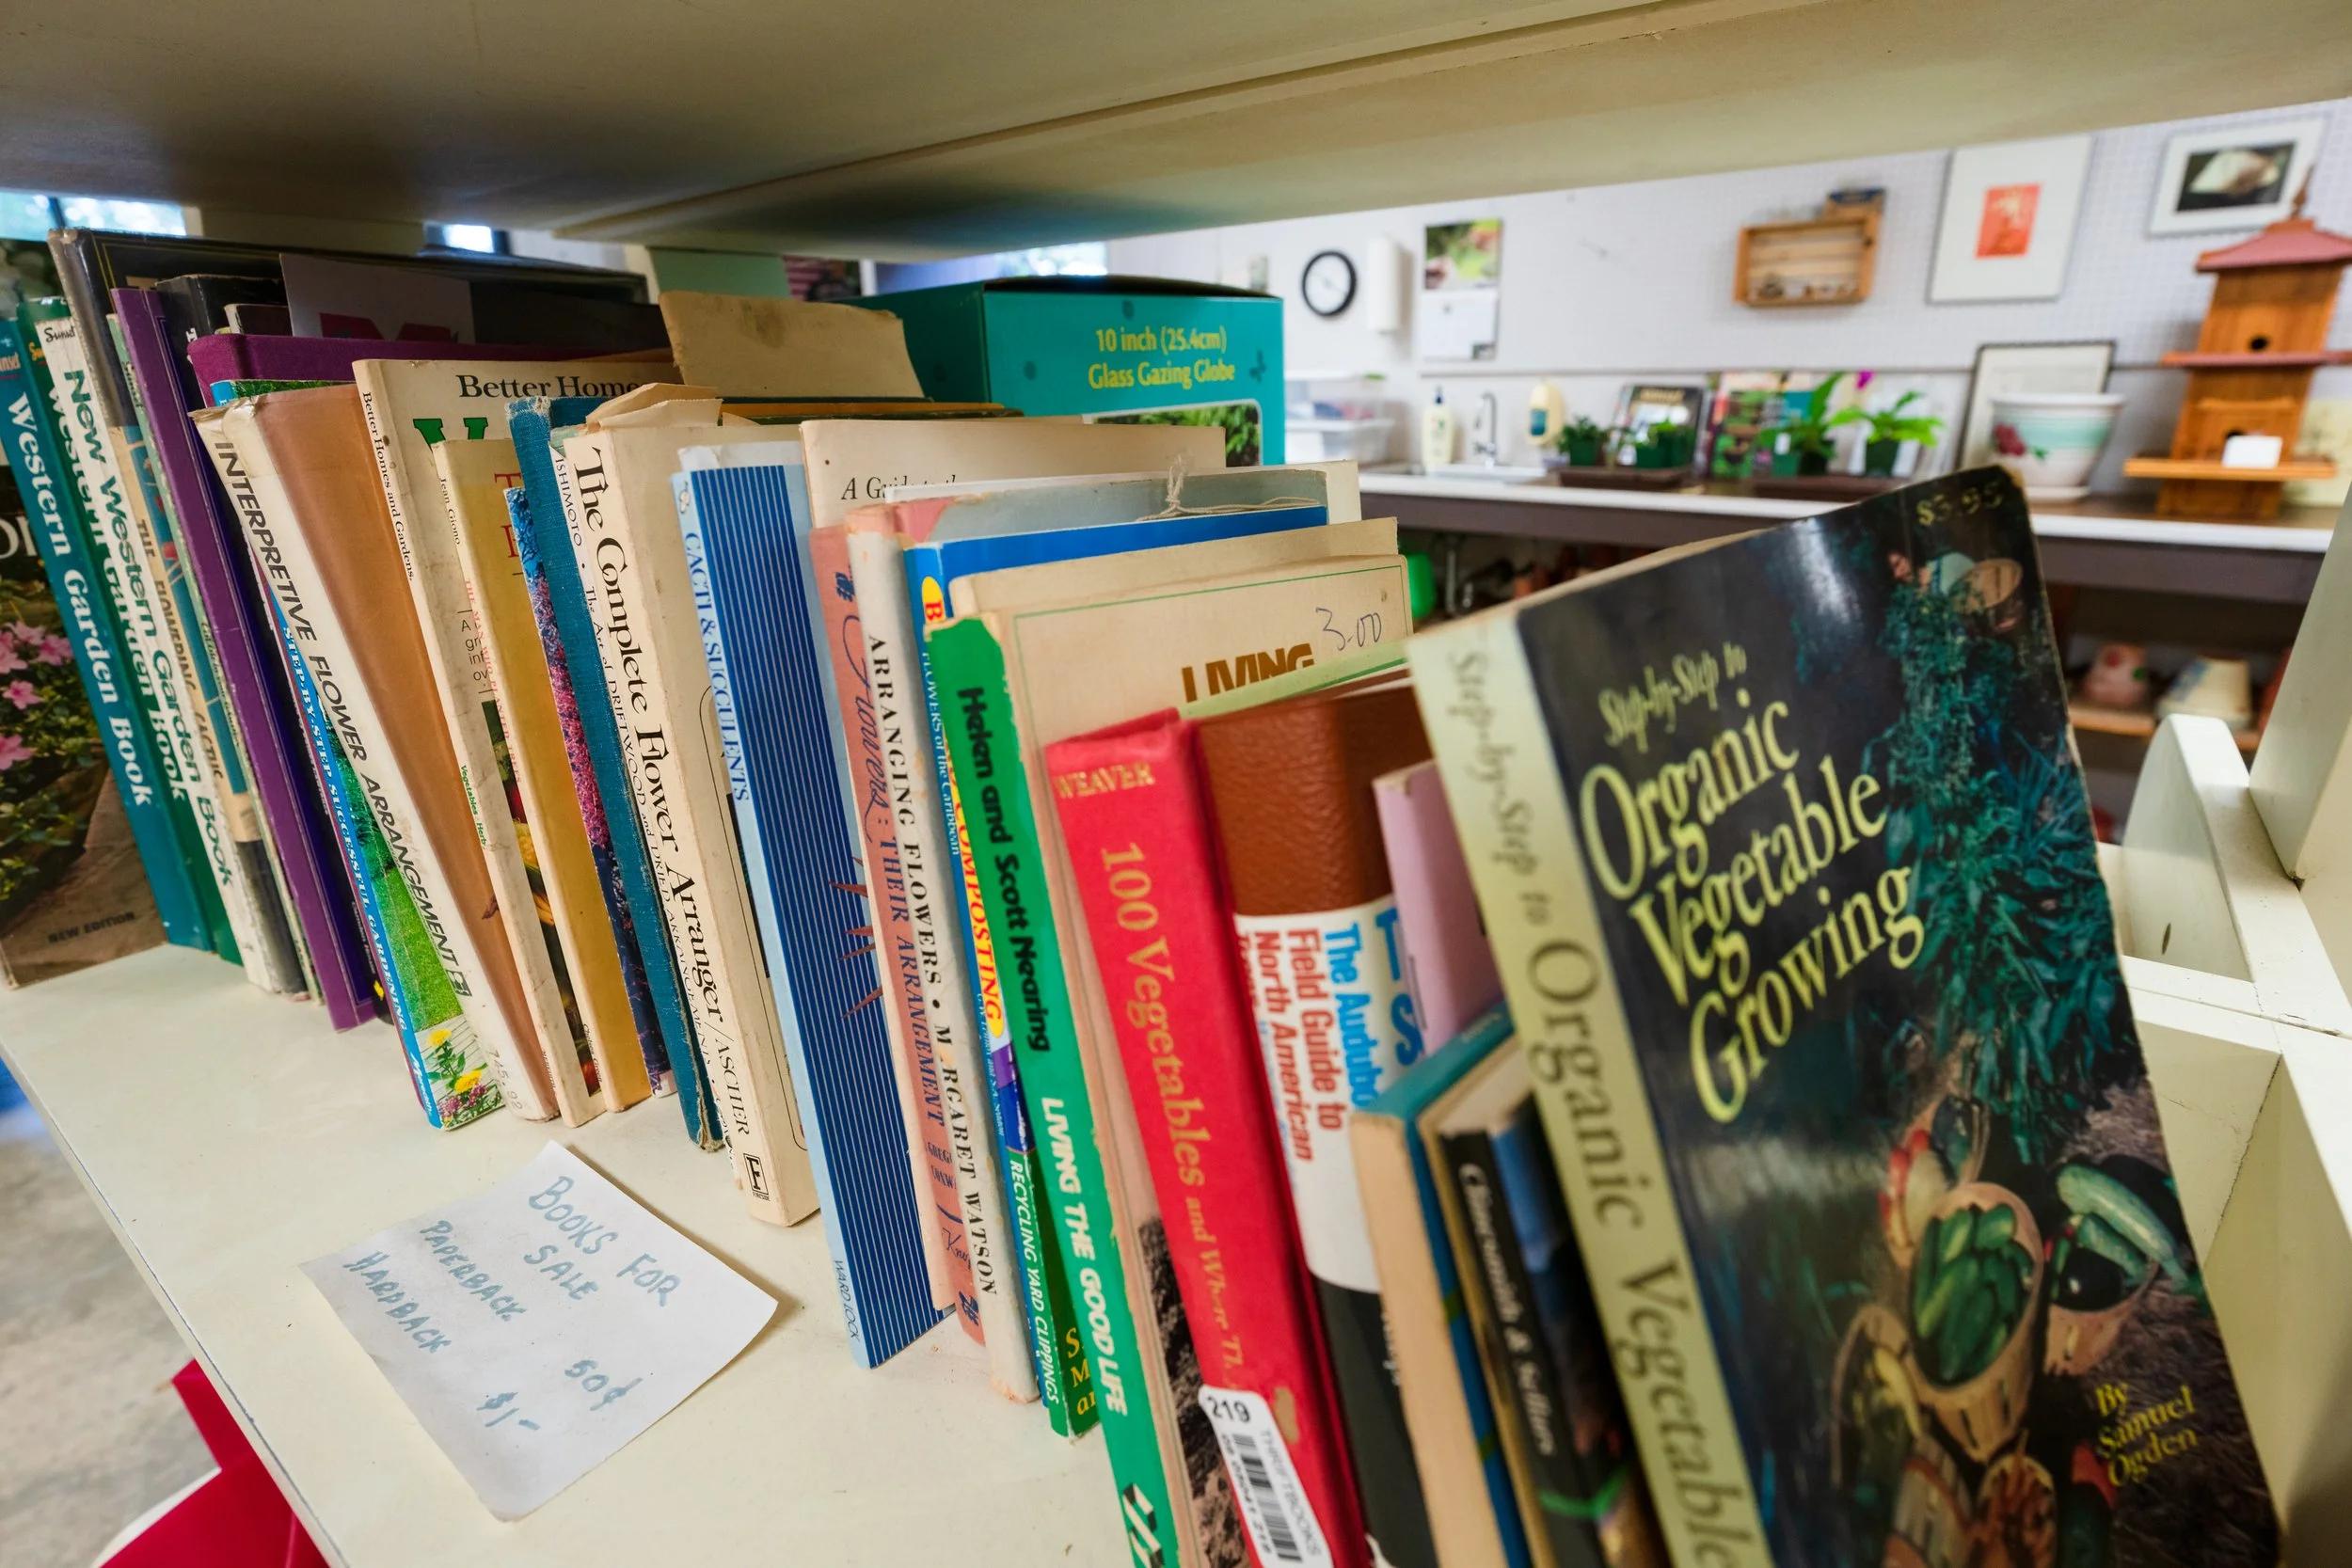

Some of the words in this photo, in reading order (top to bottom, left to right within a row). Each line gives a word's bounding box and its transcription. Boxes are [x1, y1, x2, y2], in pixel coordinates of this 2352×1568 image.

[43, 325, 75, 343] Sunset
[1088, 363, 1135, 389] Glass
[1136, 361, 1193, 390] Gazing
[1194, 358, 1235, 383] Globe
[1096, 328, 1117, 352] 10
[1120, 325, 1157, 352] inch
[1160, 325, 1227, 356] (25.4cm)
[456, 374, 550, 398] Better
[556, 374, 649, 397] Home
[362, 391, 378, 437] Better
[374, 437, 391, 490] Homes
[387, 491, 401, 518] and
[841, 477, 859, 500] A
[439, 478, 451, 504] Jean
[448, 509, 461, 546] Giono
[8, 391, 72, 557] Western
[64, 569, 119, 704] Garden
[109, 716, 151, 805] Book
[685, 532, 711, 610] CACTI
[64, 370, 107, 464] New
[100, 475, 158, 637] Western
[152, 649, 201, 784] Garden
[196, 796, 234, 887] Book
[461, 619, 471, 632] A
[466, 579, 475, 604] THE
[472, 611, 484, 640] MAN
[482, 646, 493, 674] WHO
[490, 681, 510, 739] PLANTED
[554, 458, 582, 547] ISHIMOTO
[584, 587, 596, 612] The
[593, 622, 606, 650] Art
[609, 680, 646, 806] DRIFTWOOD
[642, 813, 654, 837] and
[700, 618, 717, 636] &
[1315, 606, 1382, 651] 3.00
[214, 441, 318, 641] INTERPRETIVE
[309, 656, 368, 762] FLOWER
[360, 772, 460, 968] ARRANGEMENT
[706, 642, 750, 801] SUCCULENTS
[922, 652, 942, 732] FLOWERS
[957, 687, 993, 779] Helen
[1598, 651, 1719, 752] Step-by-Step
[1724, 641, 1747, 679] to
[149, 709, 186, 801] Book
[460, 765, 478, 816] Vegetables
[574, 446, 609, 531] The
[596, 537, 647, 715] Complete
[635, 724, 678, 853] Flower
[665, 862, 723, 1022] Arranger
[715, 1038, 750, 1135] ASCHER
[1054, 761, 1155, 800] WEAVER
[1579, 688, 1799, 900] Organic
[282, 626, 332, 779] STEP-BY-STEP
[329, 784, 370, 909] SUCCESSFUL
[368, 914, 407, 1031] GARDENING
[981, 785, 1013, 844] and
[995, 853, 1030, 932] Scott
[1101, 841, 1160, 931] 100
[1628, 754, 1887, 1006] Vegetable
[48, 926, 78, 943] NEW
[84, 911, 135, 933] EDITION
[868, 635, 915, 826] ARRANGING
[903, 843, 942, 986] FLOWERS
[933, 1024, 976, 1180] MRGARET
[964, 1192, 997, 1295] WATSON
[1286, 927, 1329, 1000] Field
[1325, 922, 1361, 985] The
[880, 836, 909, 923] THEIR
[897, 936, 944, 1126] ARRANGEMENT
[1009, 936, 1052, 1053] Nearing
[1253, 930, 1292, 1014] North
[1689, 866, 1924, 1123] Growing
[1126, 935, 1211, 1187] Vegetables
[1270, 1022, 1313, 1162] American
[1301, 1009, 1342, 1093] Guide
[1041, 1097, 1082, 1196] LIVING
[1317, 1102, 1346, 1132] to
[528, 1175, 619, 1256] BOOKS
[616, 1252, 681, 1307] FOR
[1064, 1199, 1095, 1261] THE
[1185, 1195, 1216, 1242] and
[1526, 939, 1651, 1231] Organic
[1612, 1255, 1752, 1568] Vegetable
[342, 1250, 452, 1354] HARDBACK
[524, 1243, 599, 1302] SALE
[834, 1259, 851, 1302] WARD
[1010, 1160, 1037, 1260] RECYCLING
[1025, 1260, 1044, 1310] YARD
[1036, 1315, 1059, 1404] CLIPPINGS
[1078, 1267, 1113, 1358] GOOD
[1200, 1246, 1232, 1325] Where
[419, 1219, 526, 1323] PAPERBACK
[564, 1359, 644, 1412] 50¢
[1097, 1358, 1129, 1418] LIFE
[1206, 1395, 1250, 1422] 219
[2096, 1382, 2129, 1418] By
[2097, 1384, 2195, 1459] Samuel
[2106, 1427, 2198, 1487] Ogden
